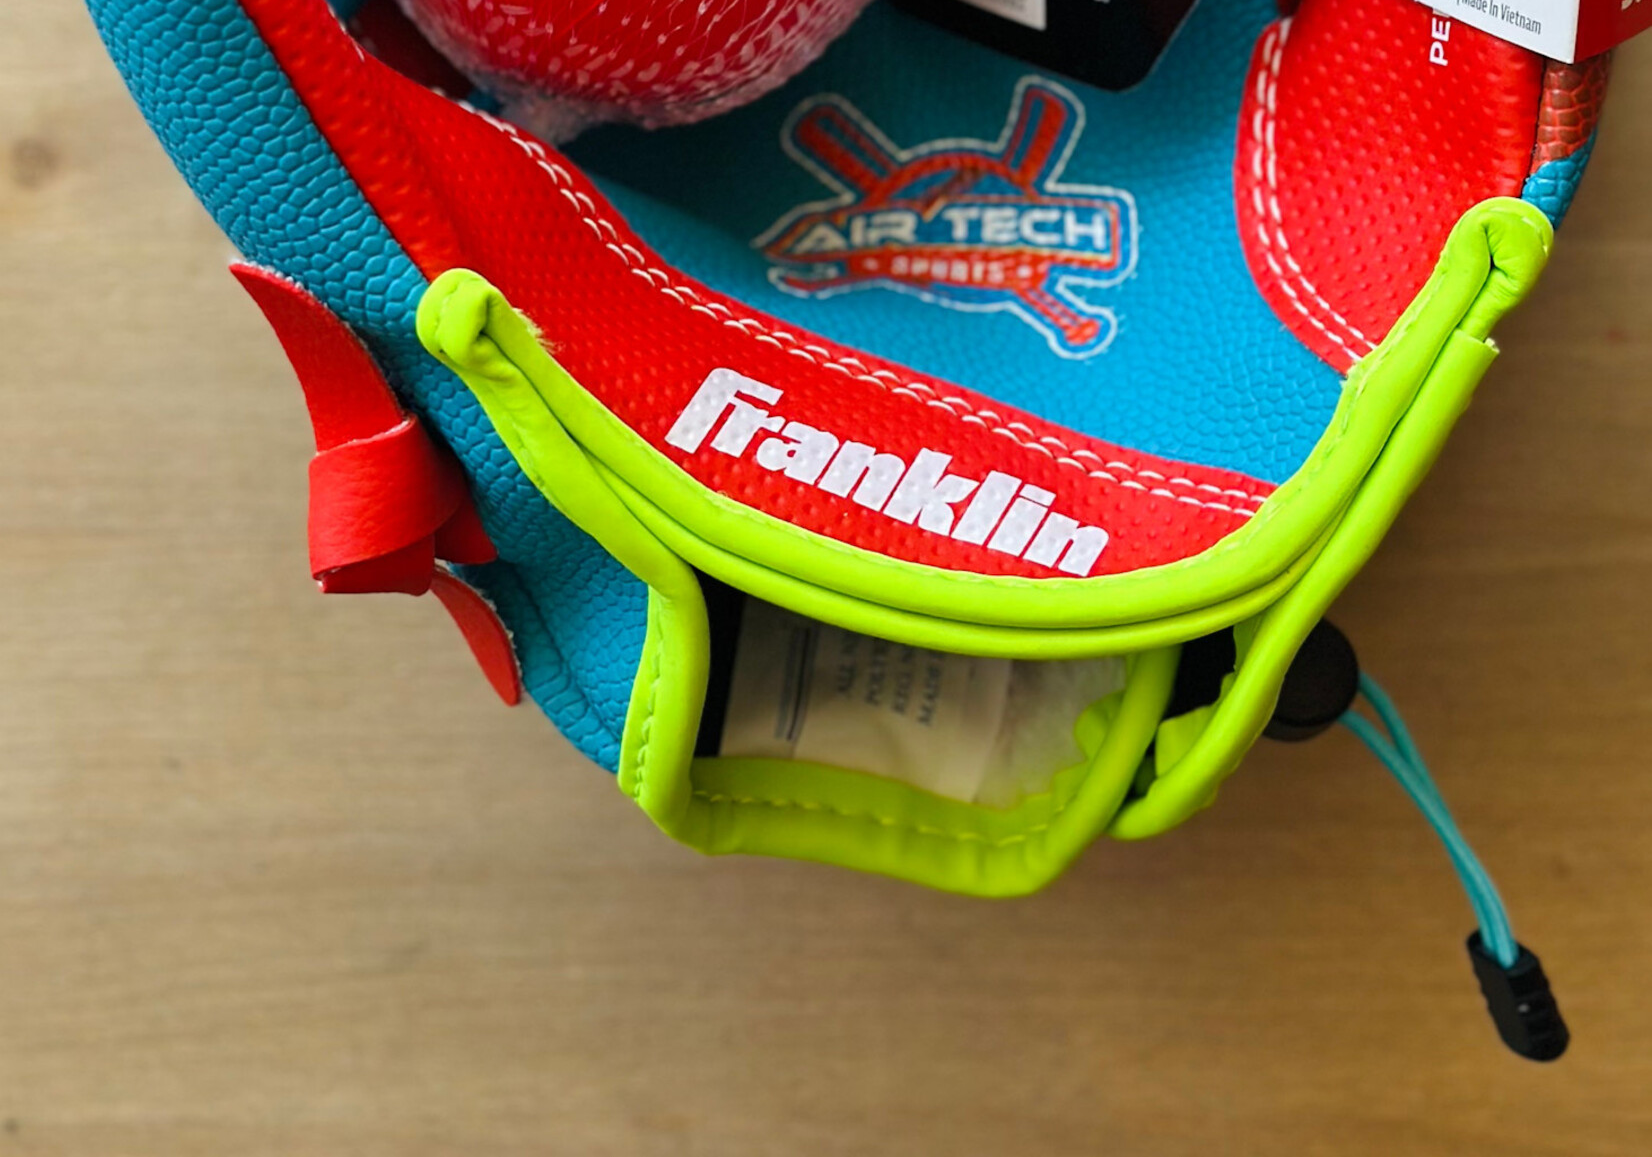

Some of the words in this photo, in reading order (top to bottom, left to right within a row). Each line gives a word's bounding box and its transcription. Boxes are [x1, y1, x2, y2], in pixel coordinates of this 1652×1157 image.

[1429, 10, 1451, 66] PE
[1489, 1, 1499, 18] In
[1501, 6, 1542, 35] Vietnam
[793, 209, 917, 255] AIR
[942, 207, 1108, 250] TECH
[664, 367, 1109, 577] Franklin
